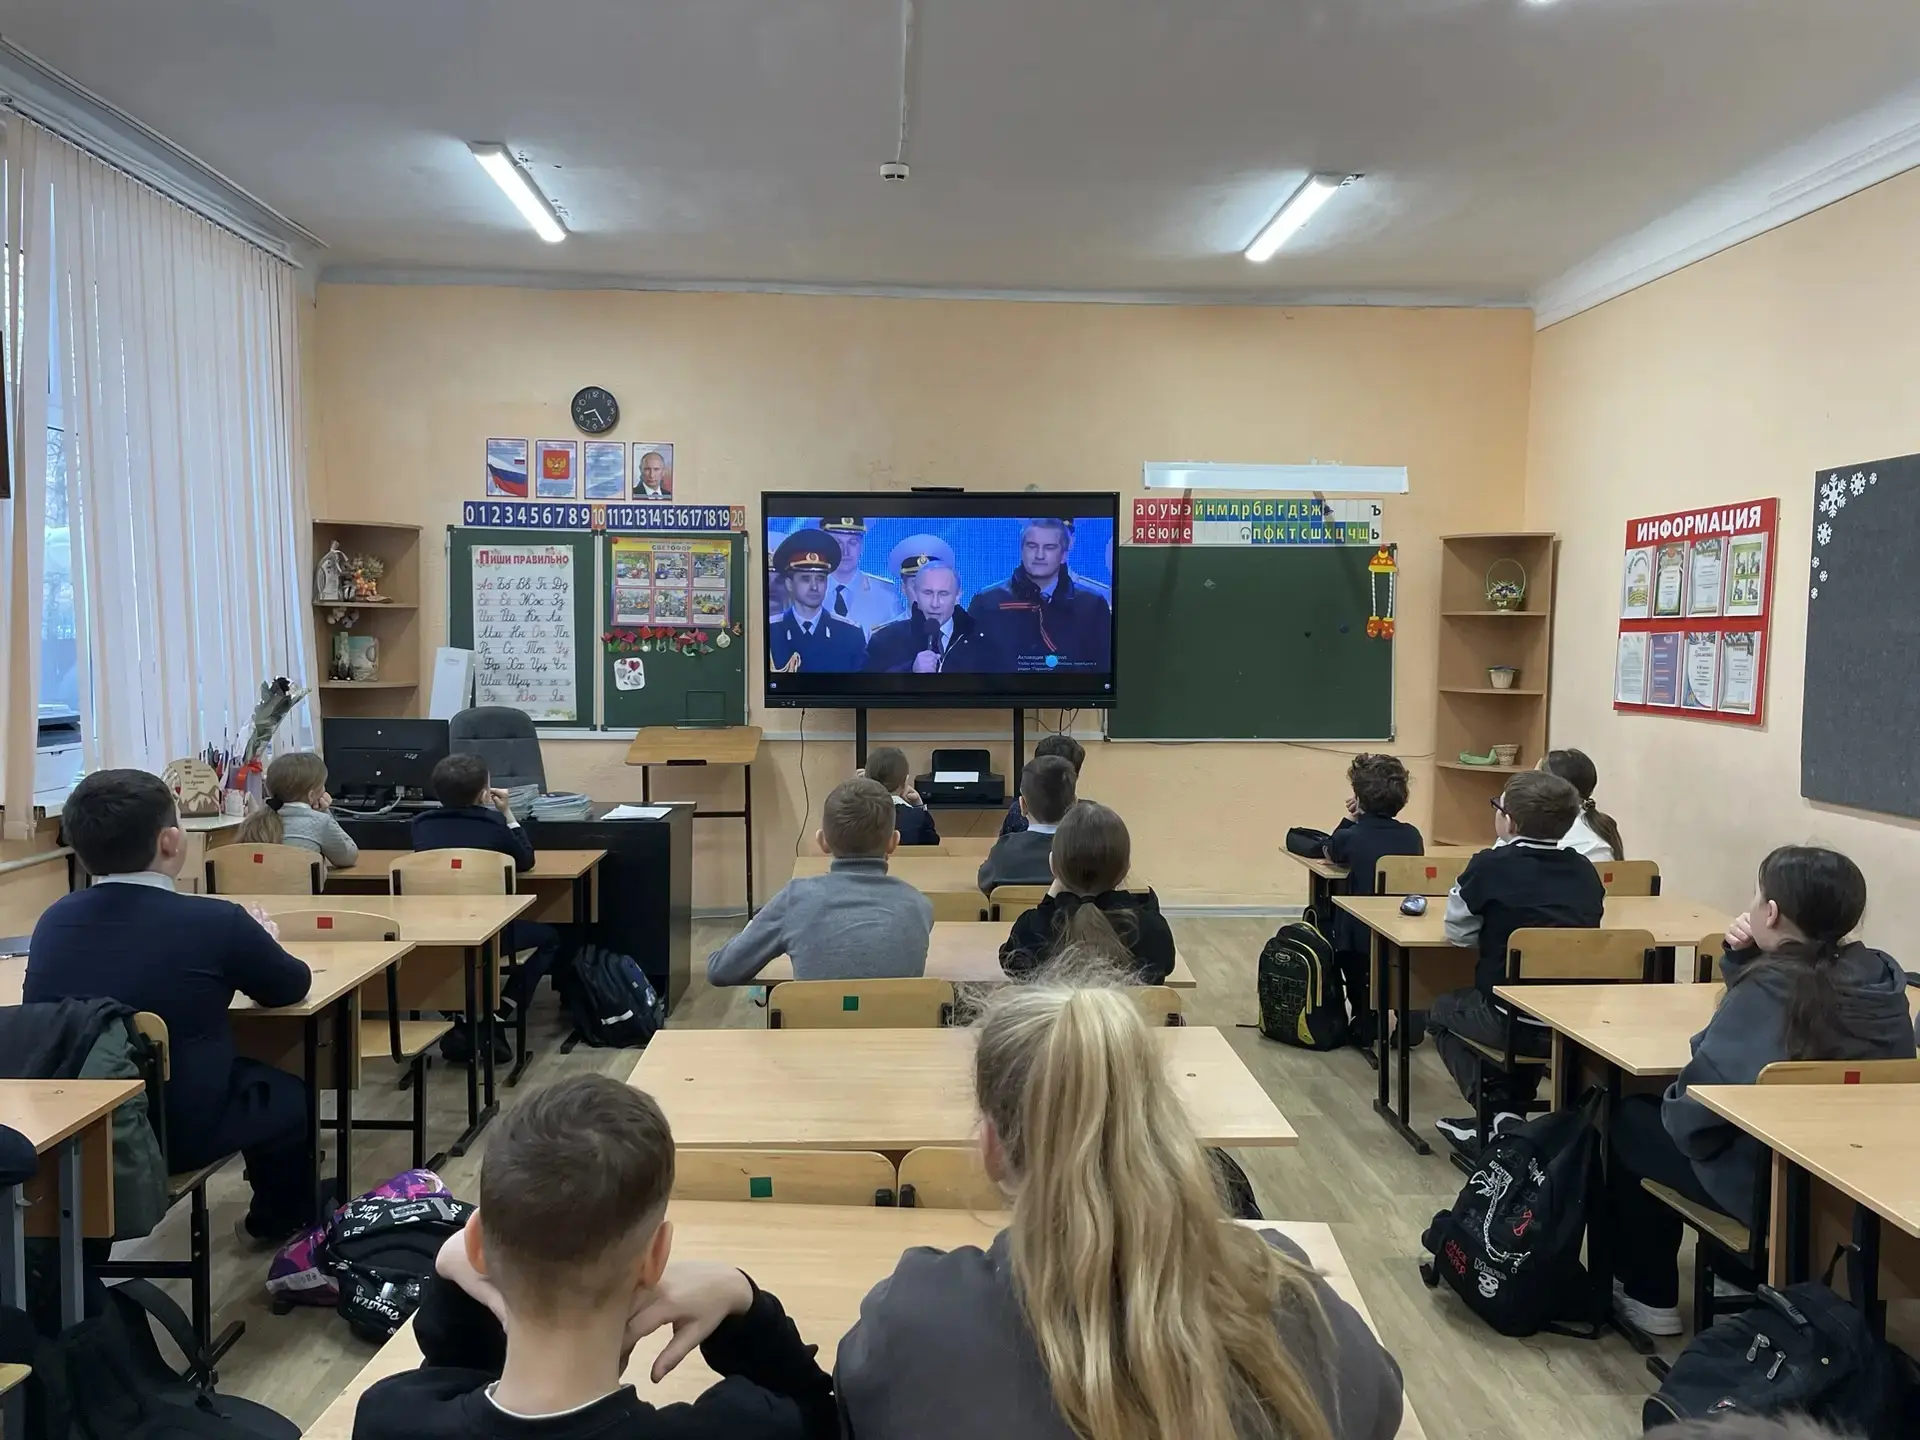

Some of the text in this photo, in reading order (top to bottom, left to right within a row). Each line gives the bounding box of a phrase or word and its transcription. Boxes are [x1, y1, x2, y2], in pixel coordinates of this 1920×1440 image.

[466, 506, 743, 526] 0 1 2 3 4 5 6 7 8 9 10 11 12 13 14 15 16 17 18 19 20
[1136, 504, 1144, 515] а
[1148, 504, 1155, 515] о
[1160, 504, 1168, 519] у
[1171, 504, 1180, 515] ы
[1184, 504, 1191, 515] э
[1196, 500, 1203, 515] й
[1207, 504, 1214, 515] н
[1218, 504, 1228, 515] м
[1230, 504, 1238, 515] л
[1242, 504, 1250, 520] р
[1254, 501, 1261, 516] б
[1266, 505, 1273, 516] в
[1278, 505, 1284, 516] г
[1288, 505, 1298, 518] д
[1302, 504, 1308, 516] з
[1311, 505, 1322, 516] ж
[1136, 528, 1144, 538] я
[1148, 524, 1155, 538] ё
[1159, 528, 1168, 538] ю
[1172, 528, 1179, 538] и
[1184, 528, 1191, 538] е
[1253, 528, 1261, 539] п
[1264, 525, 1274, 543] ф
[1277, 528, 1284, 539] к
[1289, 528, 1296, 539] т
[1301, 528, 1307, 539] с
[1311, 528, 1321, 539] ш
[1324, 528, 1332, 539] х
[1336, 528, 1344, 542] ц
[1348, 528, 1355, 539] ч
[1360, 528, 1369, 542] щ
[1636, 506, 1761, 542] ИНФОРМАЦИЯ
[514, 555, 569, 564] ПРАВИЛЬНО
